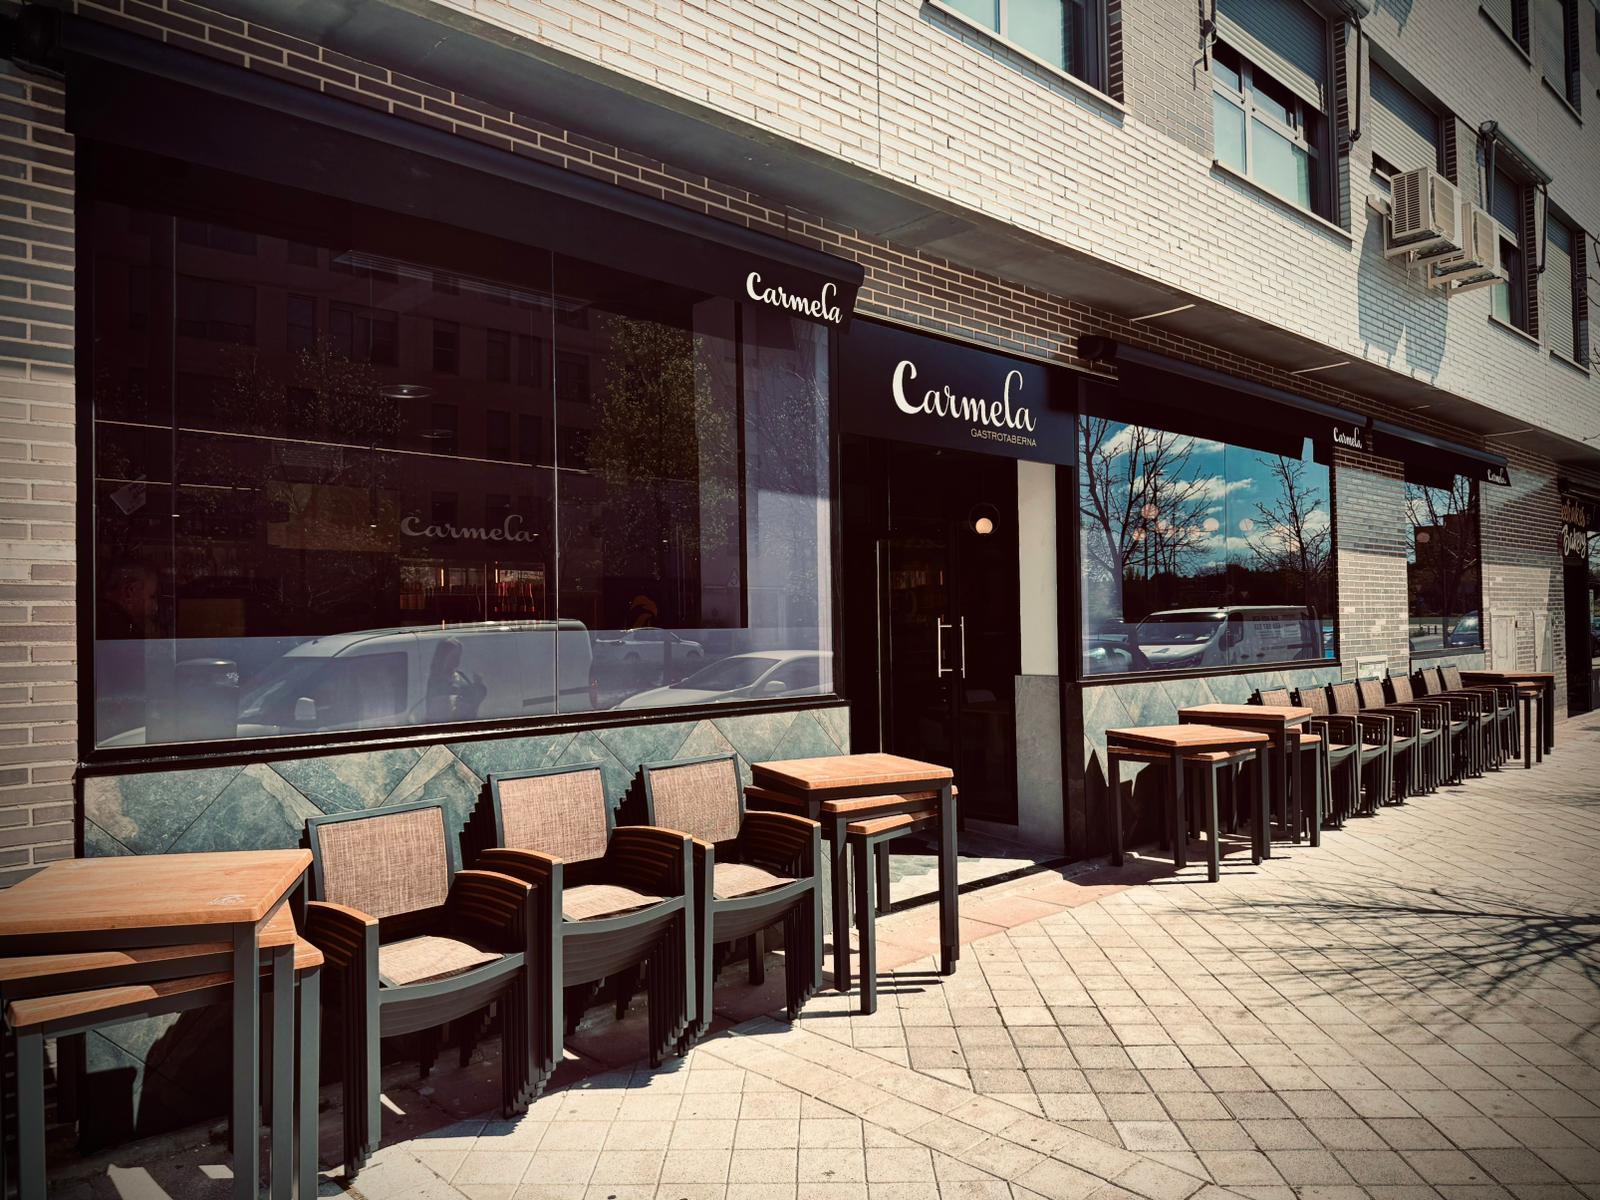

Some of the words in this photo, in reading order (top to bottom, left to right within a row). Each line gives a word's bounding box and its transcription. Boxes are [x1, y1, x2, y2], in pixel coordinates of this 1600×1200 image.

[746, 271, 843, 324] Carmela
[892, 360, 1037, 432] Carmela
[970, 428, 1037, 447] GASTROTABERNA
[1333, 427, 1363, 449] Carmela
[400, 514, 535, 543] Carmela
